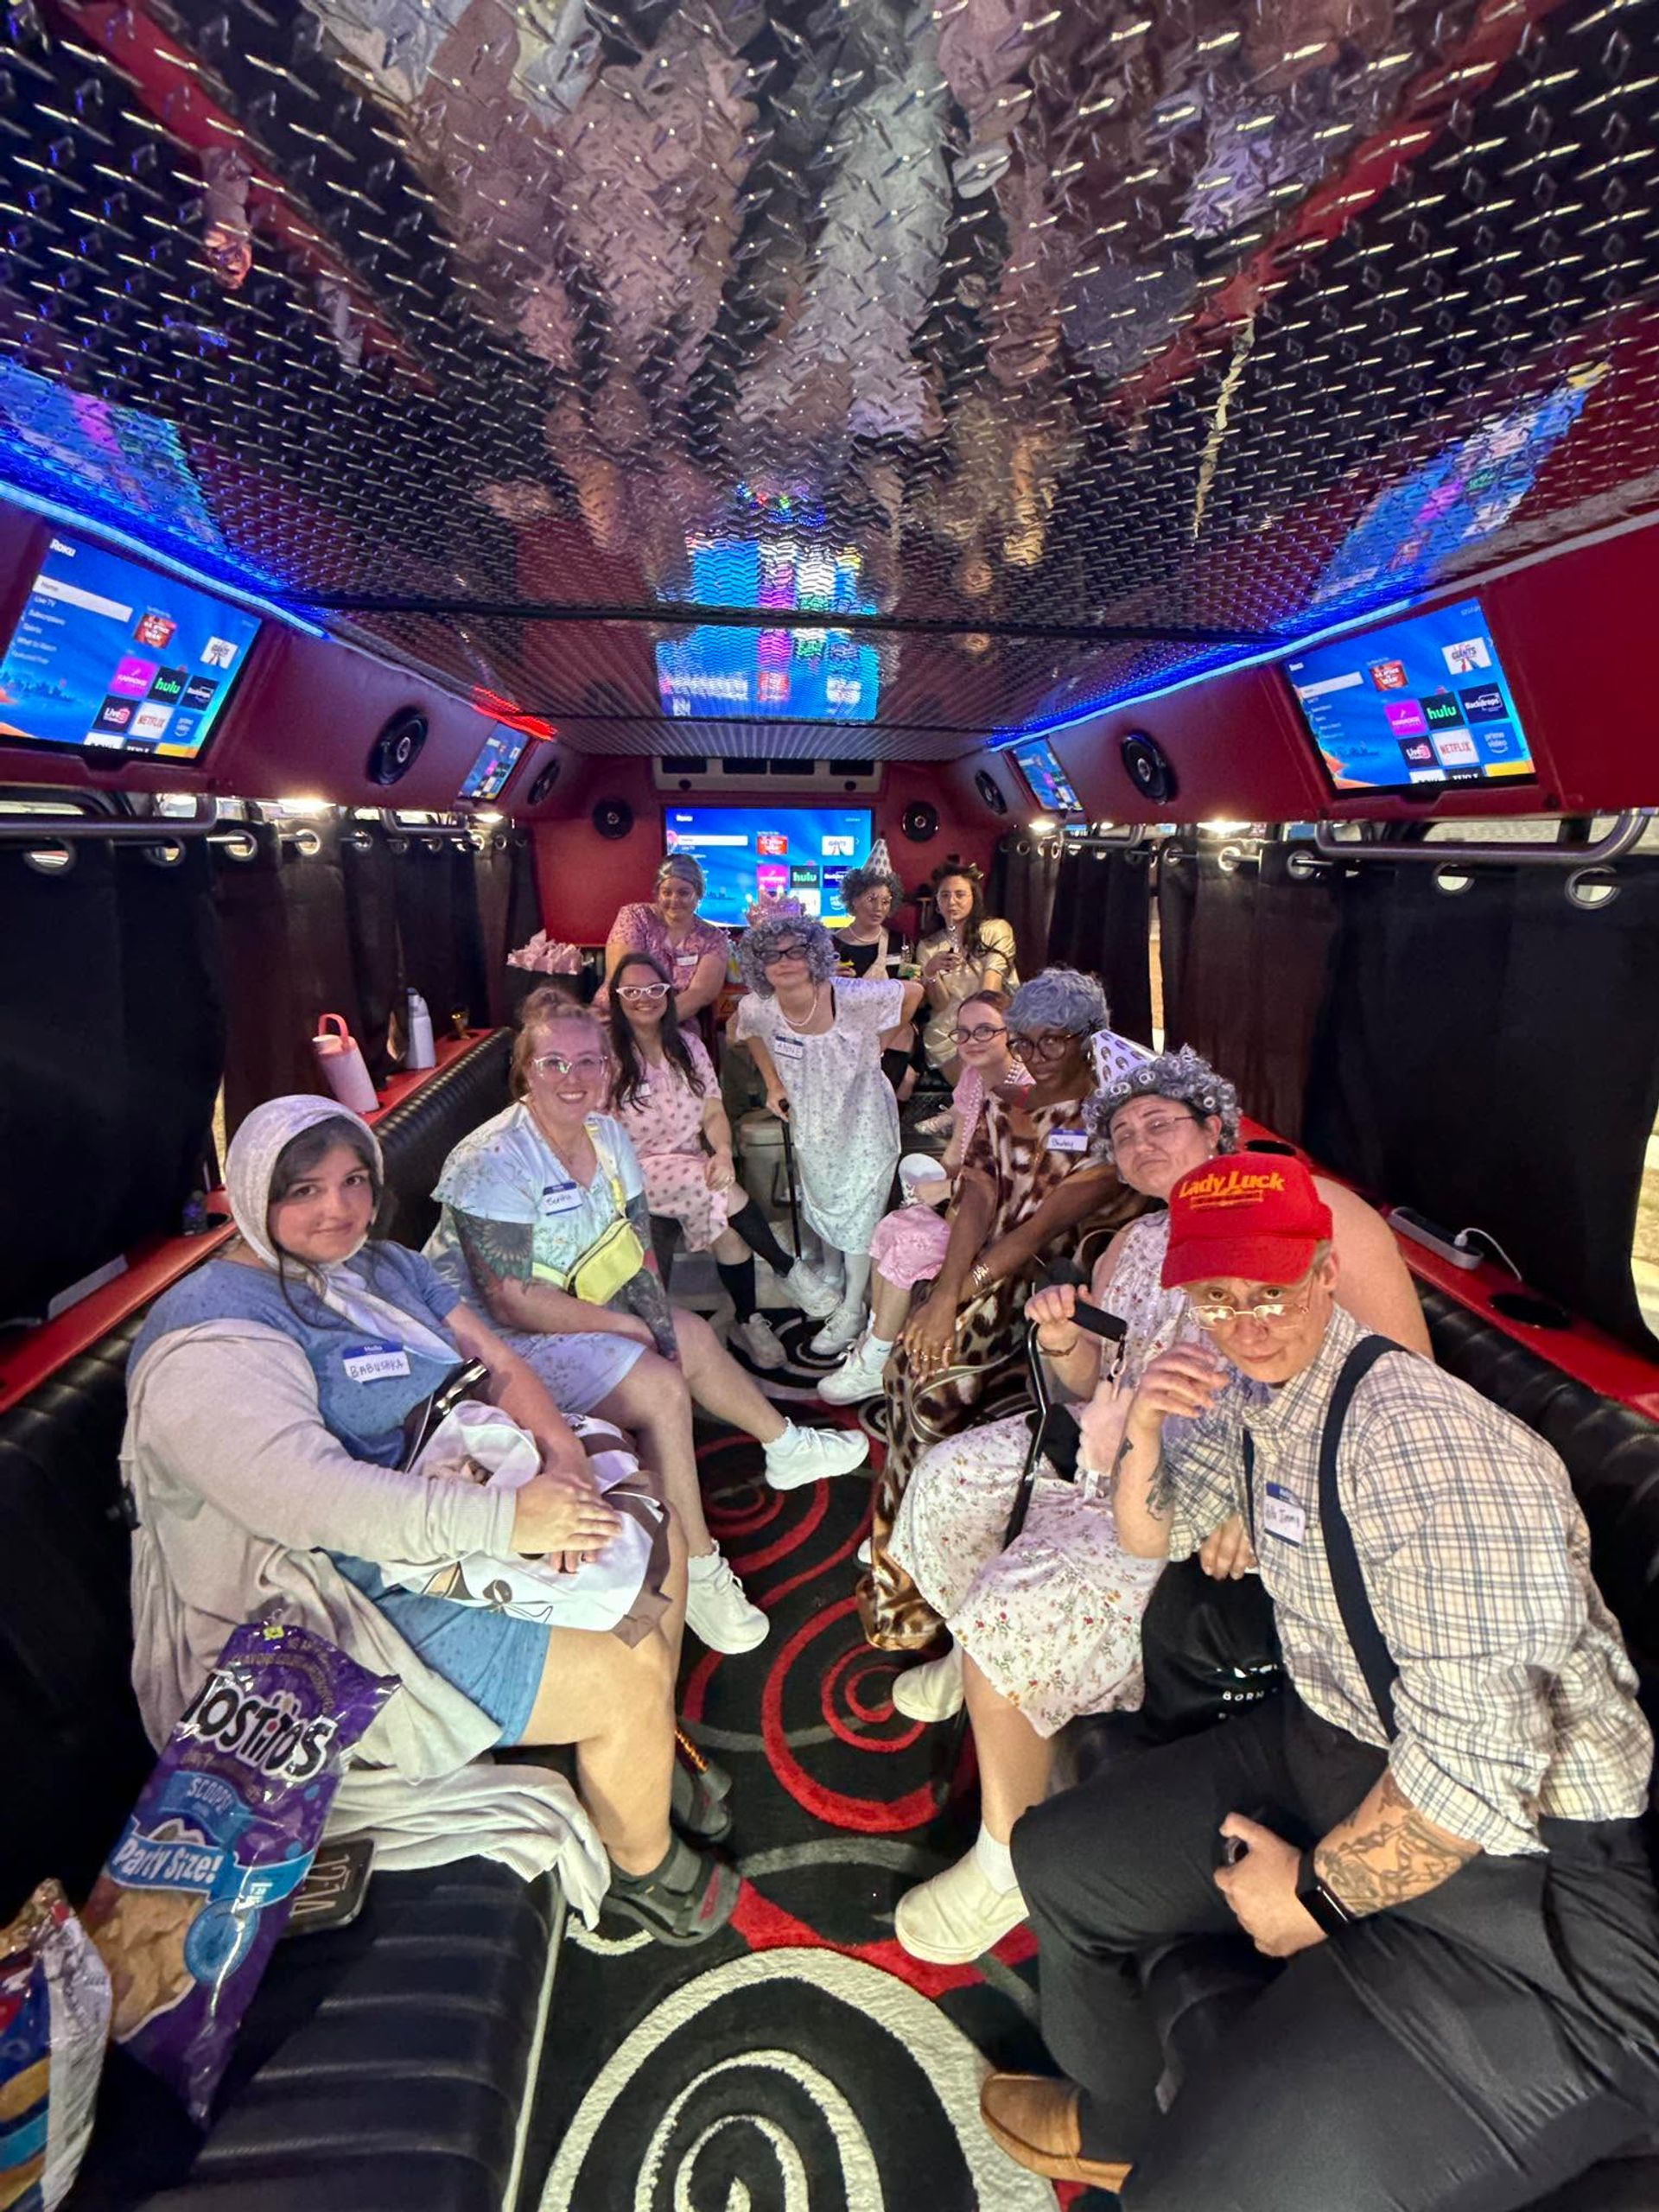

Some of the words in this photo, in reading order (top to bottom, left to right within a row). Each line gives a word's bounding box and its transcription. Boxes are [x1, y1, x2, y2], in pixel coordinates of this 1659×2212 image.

[49, 538, 76, 557] Roku
[155, 677, 181, 694] hulu
[1427, 704, 1457, 720] hulu
[137, 715, 166, 728] NETFLIX
[1440, 741, 1471, 754] NETFLIX
[793, 872, 817, 881] hulu
[1179, 1173, 1227, 1198] Lady
[1228, 1171, 1285, 1192] Luck
[112, 1837, 172, 1881] Party
[163, 1847, 225, 1884] Size!
